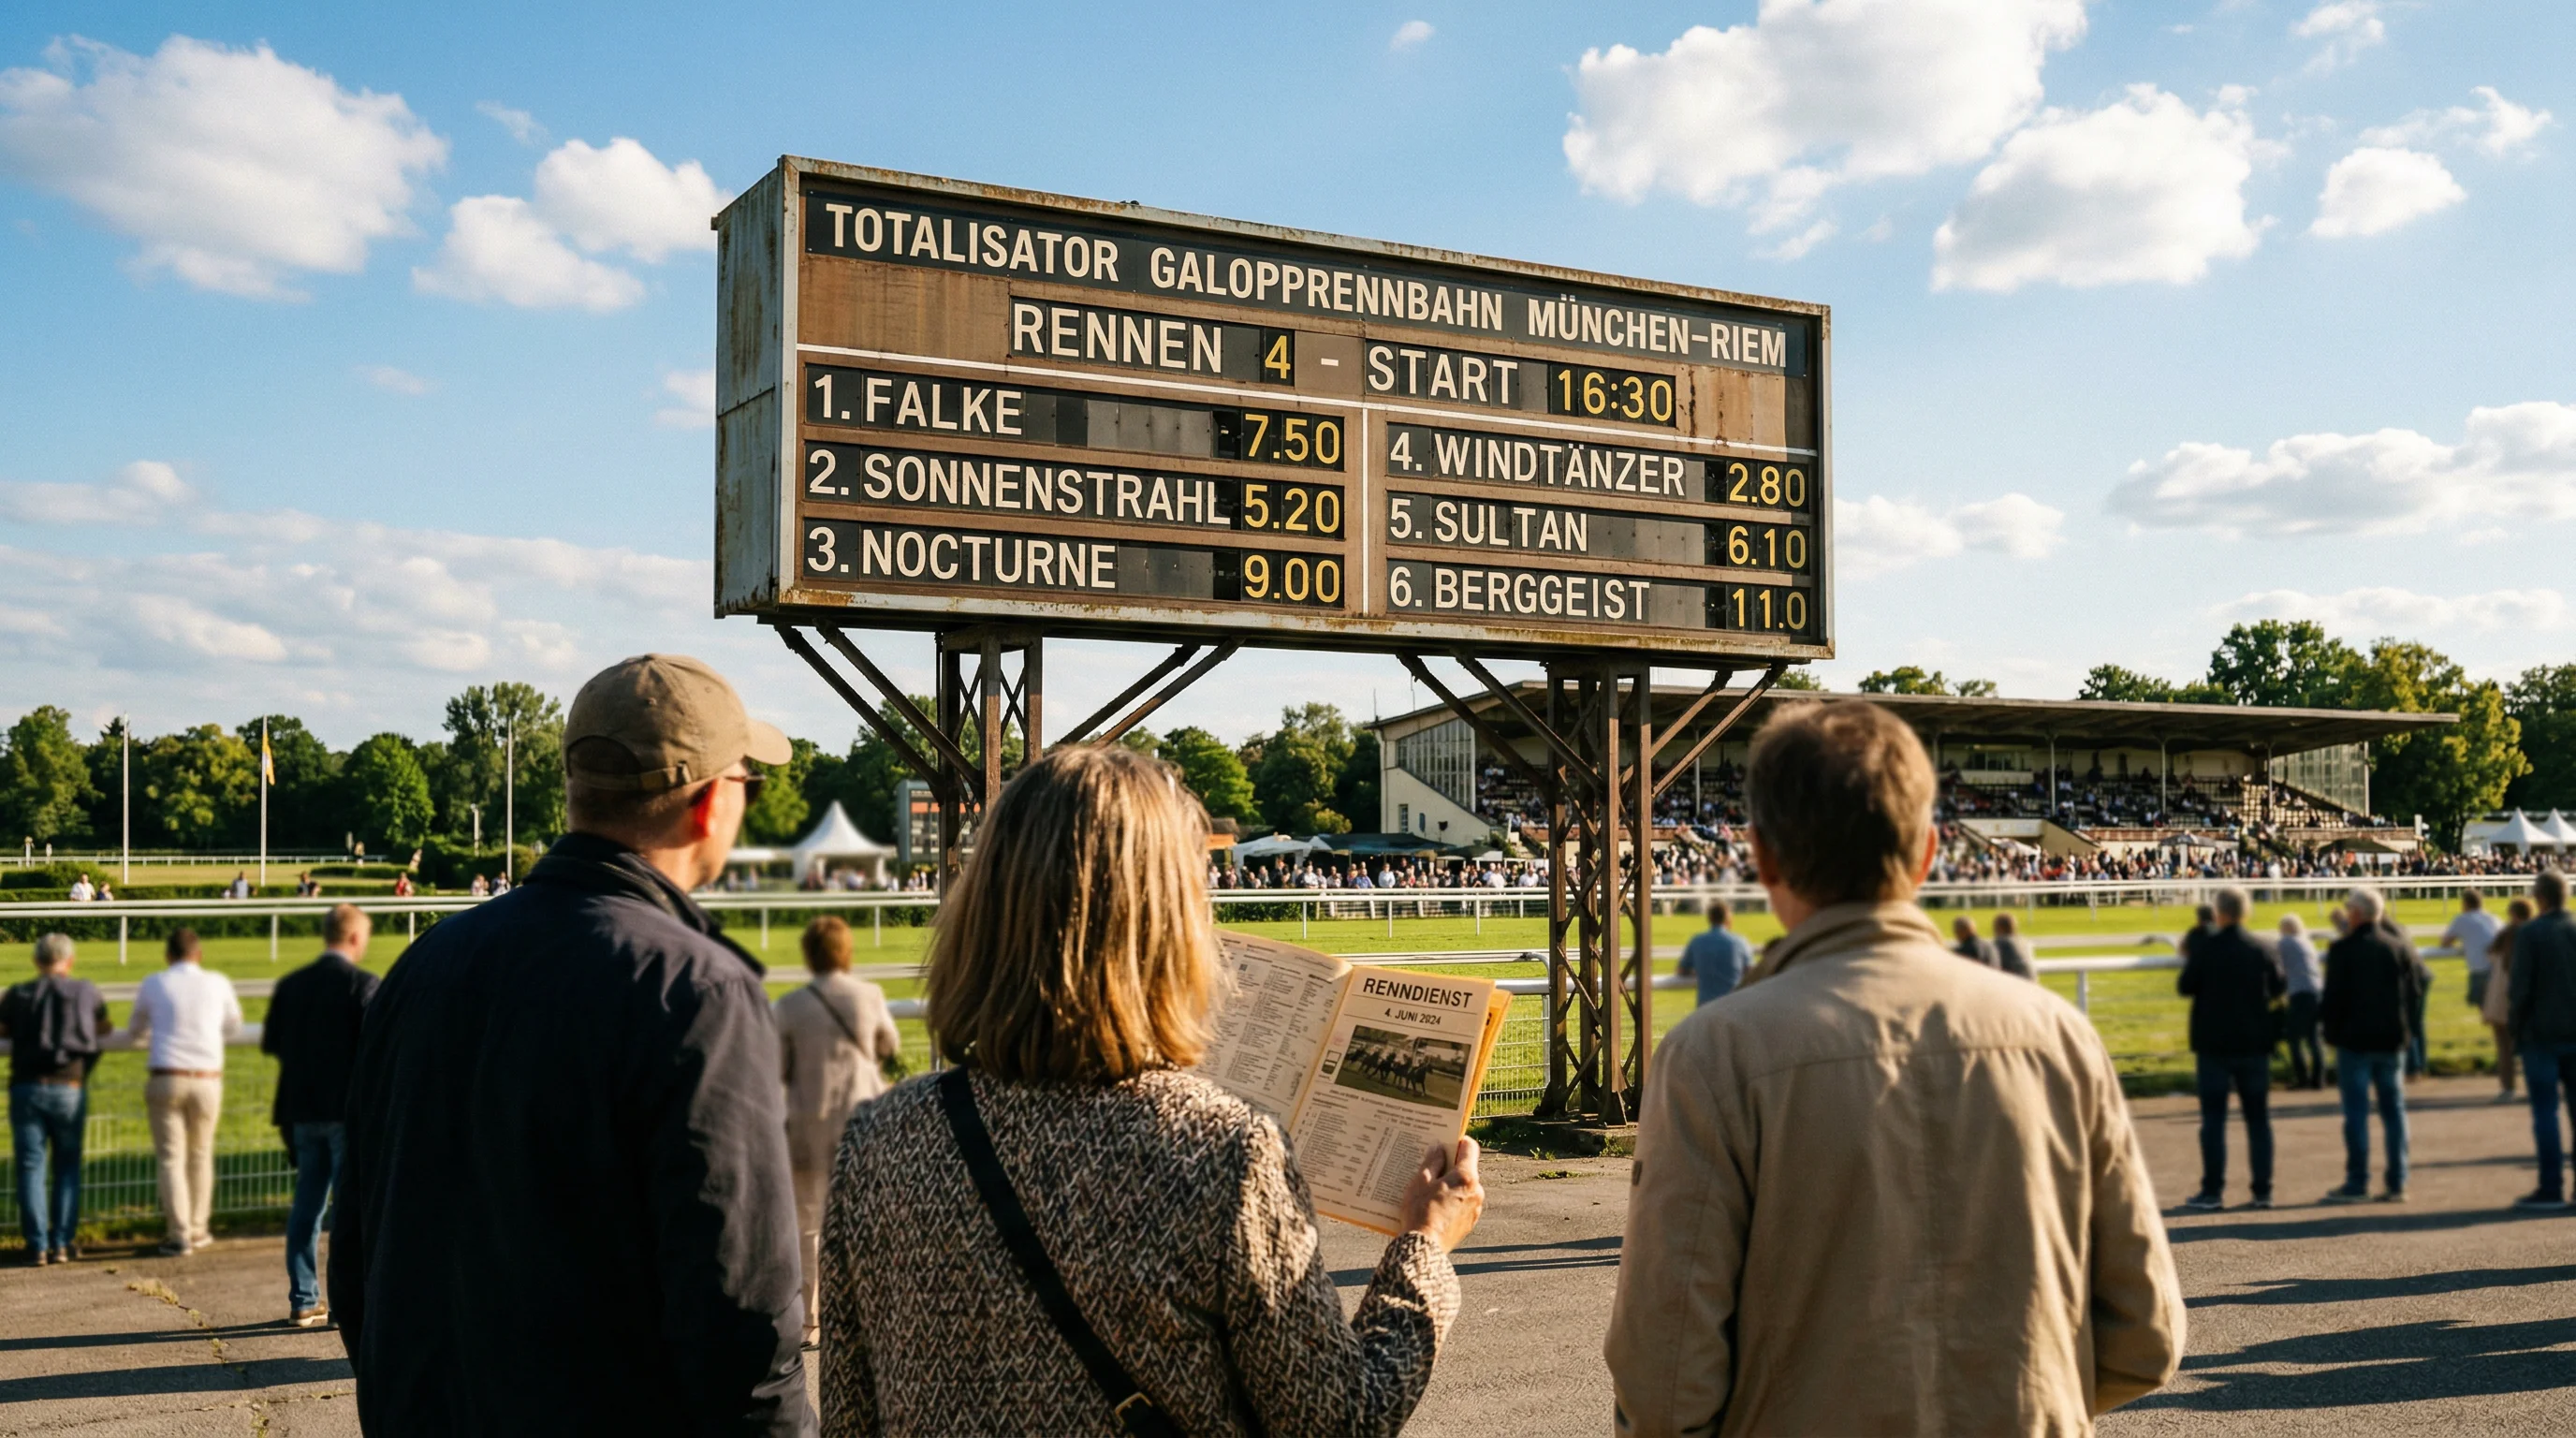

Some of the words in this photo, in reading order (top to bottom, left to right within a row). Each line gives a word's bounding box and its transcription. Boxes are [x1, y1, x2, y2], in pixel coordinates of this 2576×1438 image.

[826, 203, 1119, 282] TOTALISATOR
[1150, 247, 1502, 330] GALOPPRENNBAHN
[1529, 293, 1786, 368] MÜNCHEN-RIEM
[1013, 303, 1222, 373] RENNEN
[1265, 336, 1291, 379] 4
[1368, 345, 1518, 404] START
[1559, 369, 1673, 421] 16:30
[814, 374, 850, 420] 1.
[867, 378, 1022, 435] FALKE
[1245, 414, 1339, 464] 7.50
[809, 449, 849, 495] 2.
[864, 453, 1231, 525] SONNENSTRAHL
[1245, 483, 1339, 534] 5.20
[1390, 432, 1423, 472] 4.
[1434, 433, 1684, 496] WINDTÄNZER
[1728, 462, 1806, 507] 2.80
[808, 526, 849, 573] 3.
[862, 529, 1116, 589] NOCTURNE
[1245, 554, 1339, 603] 9.00
[1390, 498, 1423, 539] 5.
[1435, 501, 1588, 552] SULTAN
[1728, 525, 1807, 568] 6.10
[1390, 566, 1423, 608] 6.
[1435, 567, 1650, 621] BERGGEIST
[1732, 588, 1807, 630] 11.0
[1363, 977, 1472, 1008] RENNDIENST
[1395, 1009, 1418, 1022] JUNI
